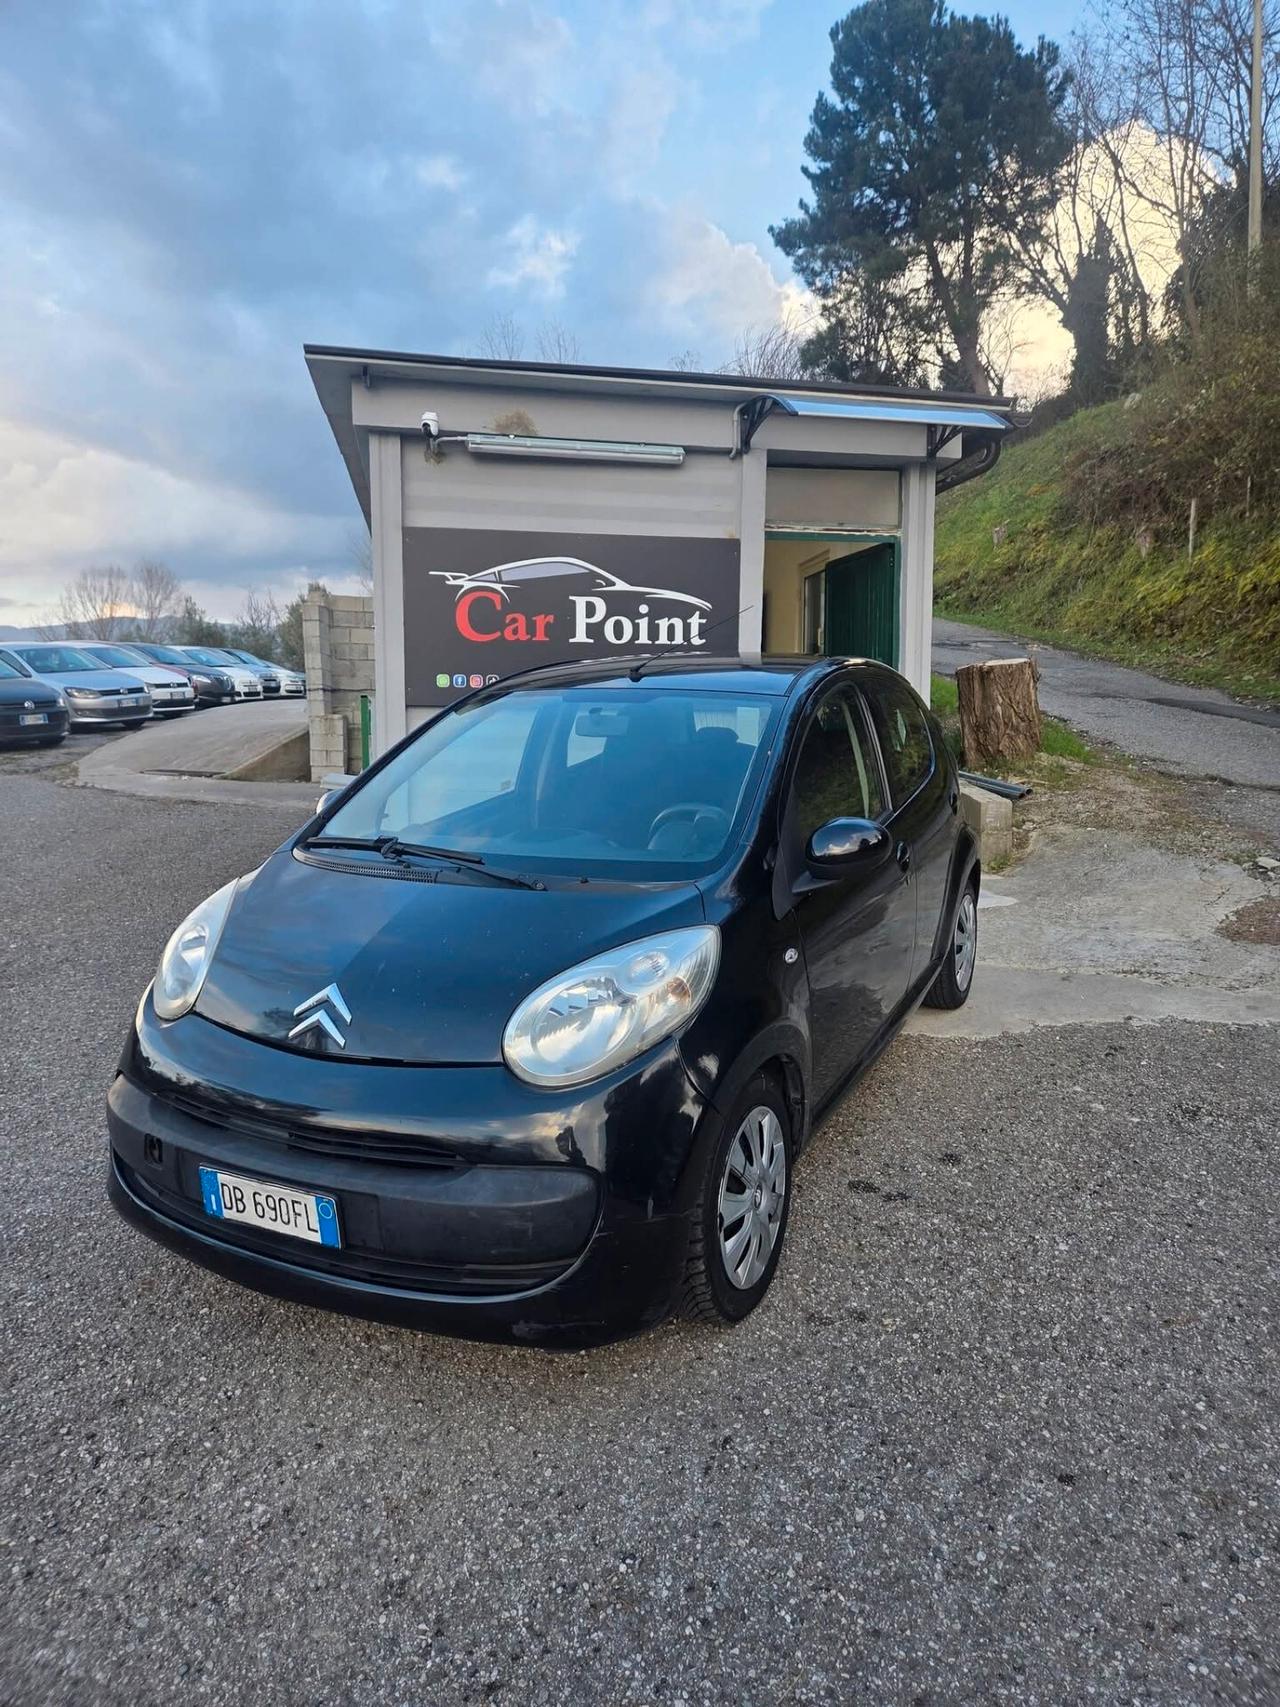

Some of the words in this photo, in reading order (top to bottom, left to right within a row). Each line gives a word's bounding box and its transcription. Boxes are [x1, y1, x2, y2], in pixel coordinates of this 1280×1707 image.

[455, 591, 554, 642] Car
[568, 595, 707, 645] Point
[220, 1182, 246, 1214] DB
[252, 1191, 319, 1233] 690FL
